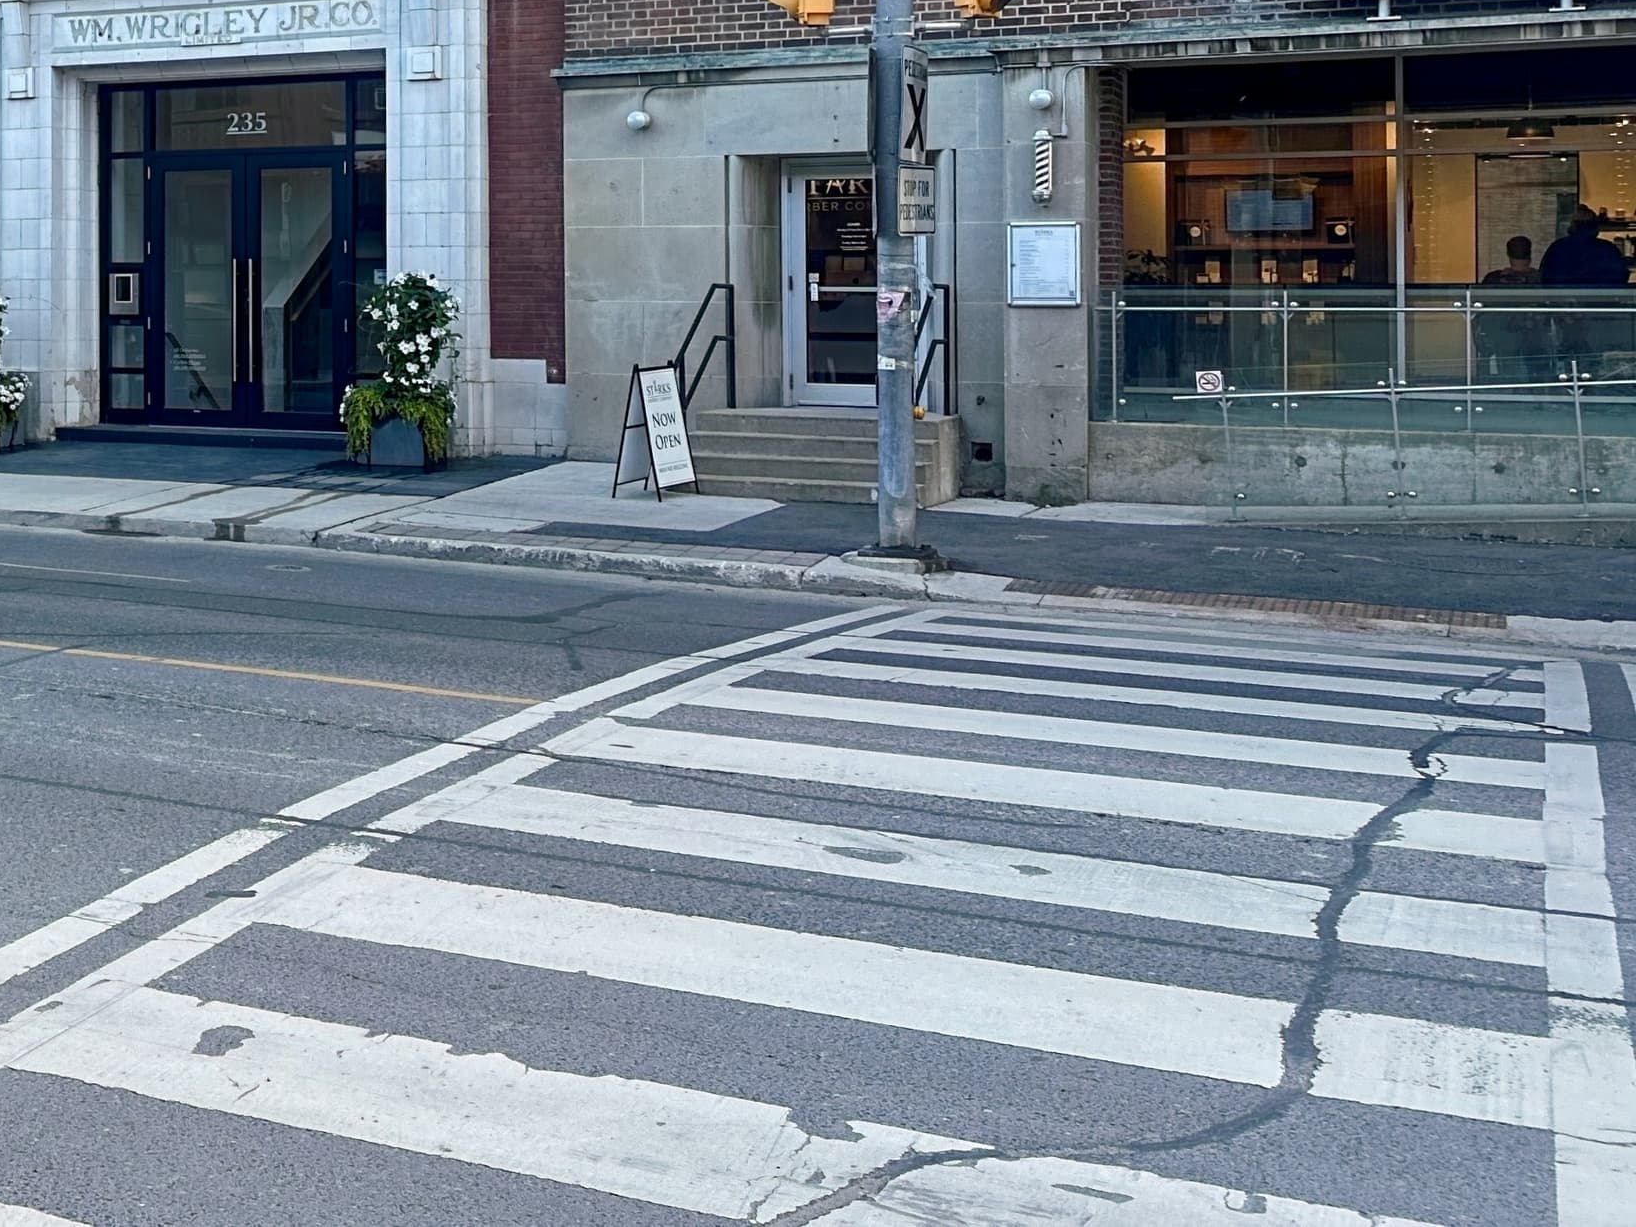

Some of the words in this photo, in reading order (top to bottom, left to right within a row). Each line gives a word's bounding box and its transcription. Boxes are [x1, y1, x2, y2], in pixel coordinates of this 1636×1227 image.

[124, 6, 269, 41] WRIGLEY
[227, 111, 267, 132] 235
[903, 179, 916, 198] STOP
[918, 180, 930, 198] FOR
[899, 203, 935, 221] PEDESTRIANS
[652, 411, 676, 429] NOW
[654, 432, 682, 451] OPEN
